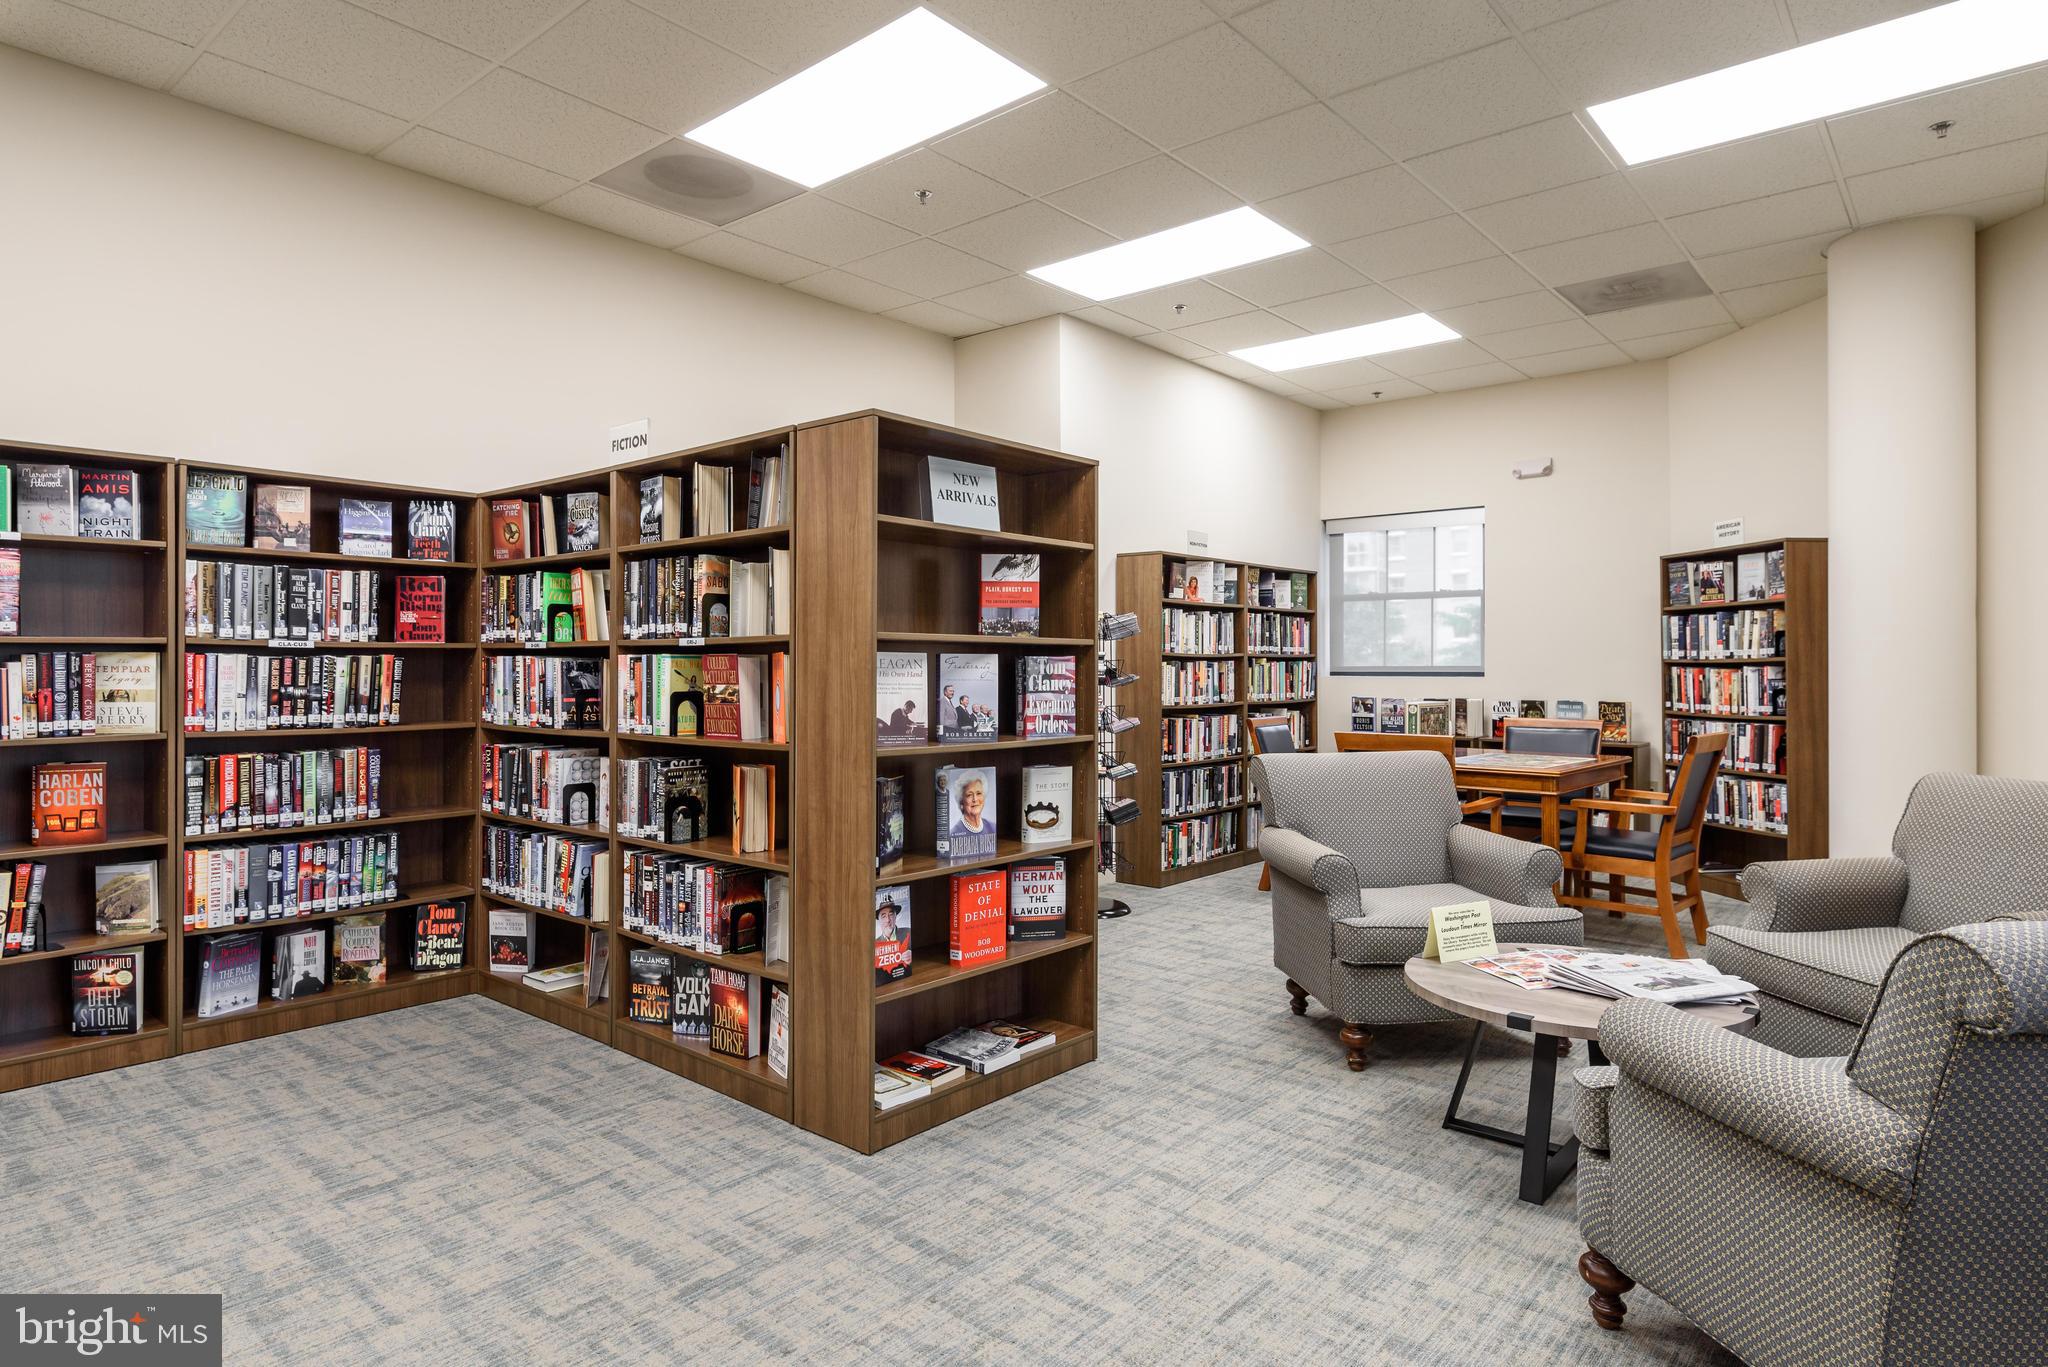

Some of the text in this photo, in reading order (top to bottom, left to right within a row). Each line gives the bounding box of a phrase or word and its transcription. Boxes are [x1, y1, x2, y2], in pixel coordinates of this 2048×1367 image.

[612, 433, 648, 452] FICTION
[22, 468, 62, 479] Margaret
[82, 473, 130, 481] MARTIN
[953, 472, 981, 487] NEW
[30, 479, 63, 487] Atwood
[82, 484, 130, 494] AMIS
[574, 498, 590, 509] CLIVE
[937, 489, 997, 507] ARRIVALS
[344, 508, 391, 518] Higgins Clark
[492, 504, 520, 512] CATCHING
[84, 518, 131, 526] NIGHT
[422, 511, 446, 526] Tom
[410, 522, 450, 538] Clancy
[642, 521, 659, 534] Chasing
[1716, 522, 1741, 530] AMERICAN
[84, 529, 131, 538] TRAIN
[640, 533, 661, 544] Darkness
[1718, 530, 1740, 538] HISTORY
[416, 538, 440, 548] Teeth
[424, 549, 449, 559] Tiger
[240, 568, 249, 607] TOM CLANCY
[332, 575, 340, 588] Tom
[400, 577, 442, 593] Red
[706, 575, 728, 588] SABO
[400, 592, 442, 602] Storm
[223, 598, 231, 618] Patriot
[400, 602, 442, 613] Rising
[410, 622, 437, 631] Tom
[400, 630, 442, 641] Clancy
[707, 656, 729, 669] COLLEEN
[879, 658, 923, 670] EAGAN
[945, 656, 992, 678] Fraternity
[1038, 659, 1067, 675] Tom
[84, 663, 92, 688] BERRY
[104, 675, 142, 685] Legacy
[392, 660, 403, 701] ROBIN COOK
[1028, 674, 1073, 694] Clancy
[100, 706, 143, 715] STEVE
[570, 705, 599, 713] AAN
[705, 704, 738, 718] FORTUNE'S
[1027, 696, 1075, 714] Executive
[1492, 705, 1516, 713] CLANCY
[1600, 703, 1623, 714] Pirate
[96, 715, 147, 724] BERRY
[566, 713, 600, 721] FRST
[1600, 713, 1622, 721] Coast
[706, 718, 737, 733] FAVORITES
[1035, 715, 1068, 734] Orders
[360, 755, 365, 767] ON
[40, 773, 103, 789] HARLAN
[225, 758, 233, 807] PATRICIA CORNWELL
[240, 761, 249, 805] PATRICIA CORNWELL
[40, 788, 104, 807] COBEN
[951, 833, 996, 856] BARBARA BUSH
[288, 850, 296, 867] CLIVE
[211, 854, 221, 883] MICHAEL
[225, 860, 233, 874] PREY
[1014, 872, 1063, 882] HERMAN
[968, 880, 1000, 892] STATE
[1023, 886, 1055, 895] WOUK
[978, 896, 991, 906] OF
[1029, 896, 1048, 904] THE
[428, 904, 456, 920] Tom
[965, 907, 1004, 922] DENIAL
[1014, 906, 1063, 915] LAWGIVER
[1445, 914, 1470, 922] Washington
[342, 927, 378, 940] CATHERINE
[418, 920, 463, 938] Clancy
[304, 936, 317, 948] NOIR
[345, 938, 375, 949] COULTER
[427, 935, 456, 949] Bear
[977, 938, 991, 946] BOB
[876, 944, 899, 956] VERNMENT
[965, 946, 1004, 959] WOODWARD
[74, 957, 132, 971] LINCOLN CHILD
[416, 951, 461, 968] Dragon
[633, 955, 670, 965] J.A. JANCE
[879, 954, 901, 966] ZERO
[219, 964, 253, 980] THE PALE
[212, 973, 257, 991] HORSEMAN
[676, 976, 710, 994] VOLK
[710, 968, 746, 990] TAMI HOAG
[88, 987, 121, 1007] DEEP
[632, 983, 670, 998] BETRAYAL
[633, 999, 670, 1020] TRUST
[675, 993, 710, 1016] GAM
[80, 1006, 129, 1028] STORM
[714, 1003, 742, 1032] DARK
[712, 1026, 745, 1056] HORSE
